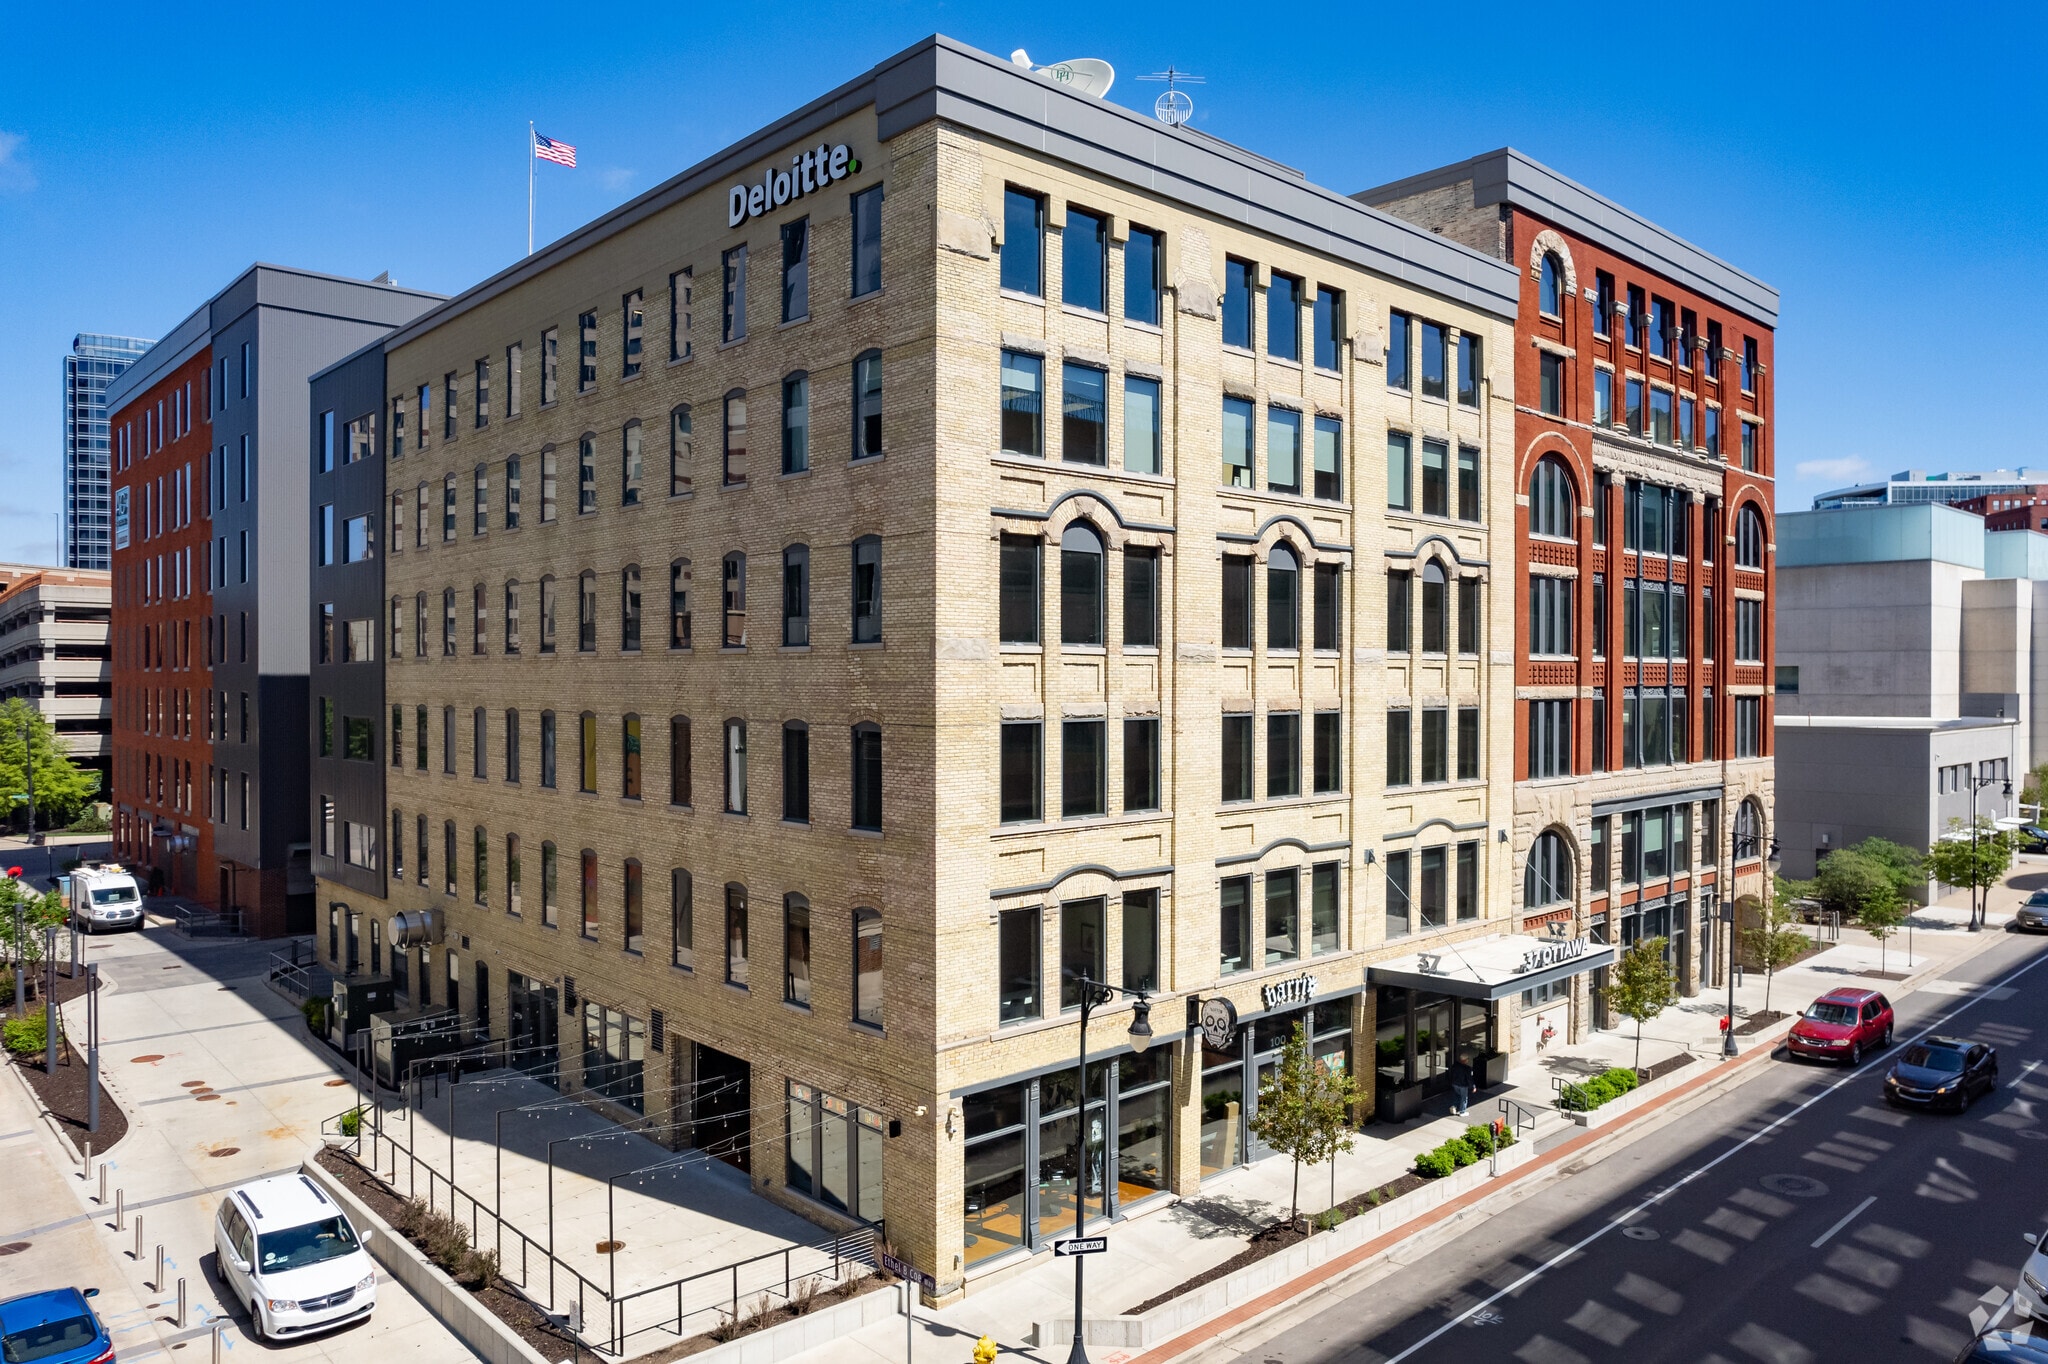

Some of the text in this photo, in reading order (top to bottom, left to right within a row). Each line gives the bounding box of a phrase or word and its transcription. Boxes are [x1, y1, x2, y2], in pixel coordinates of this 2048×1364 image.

[1417, 953, 1441, 971] 37
[1524, 937, 1588, 970] 37 OTTAWA
[1270, 1034, 1286, 1047] 100
[1068, 1241, 1102, 1251] ONE WAY
[884, 1255, 901, 1273] Ethel
[909, 1269, 922, 1283] Coe
